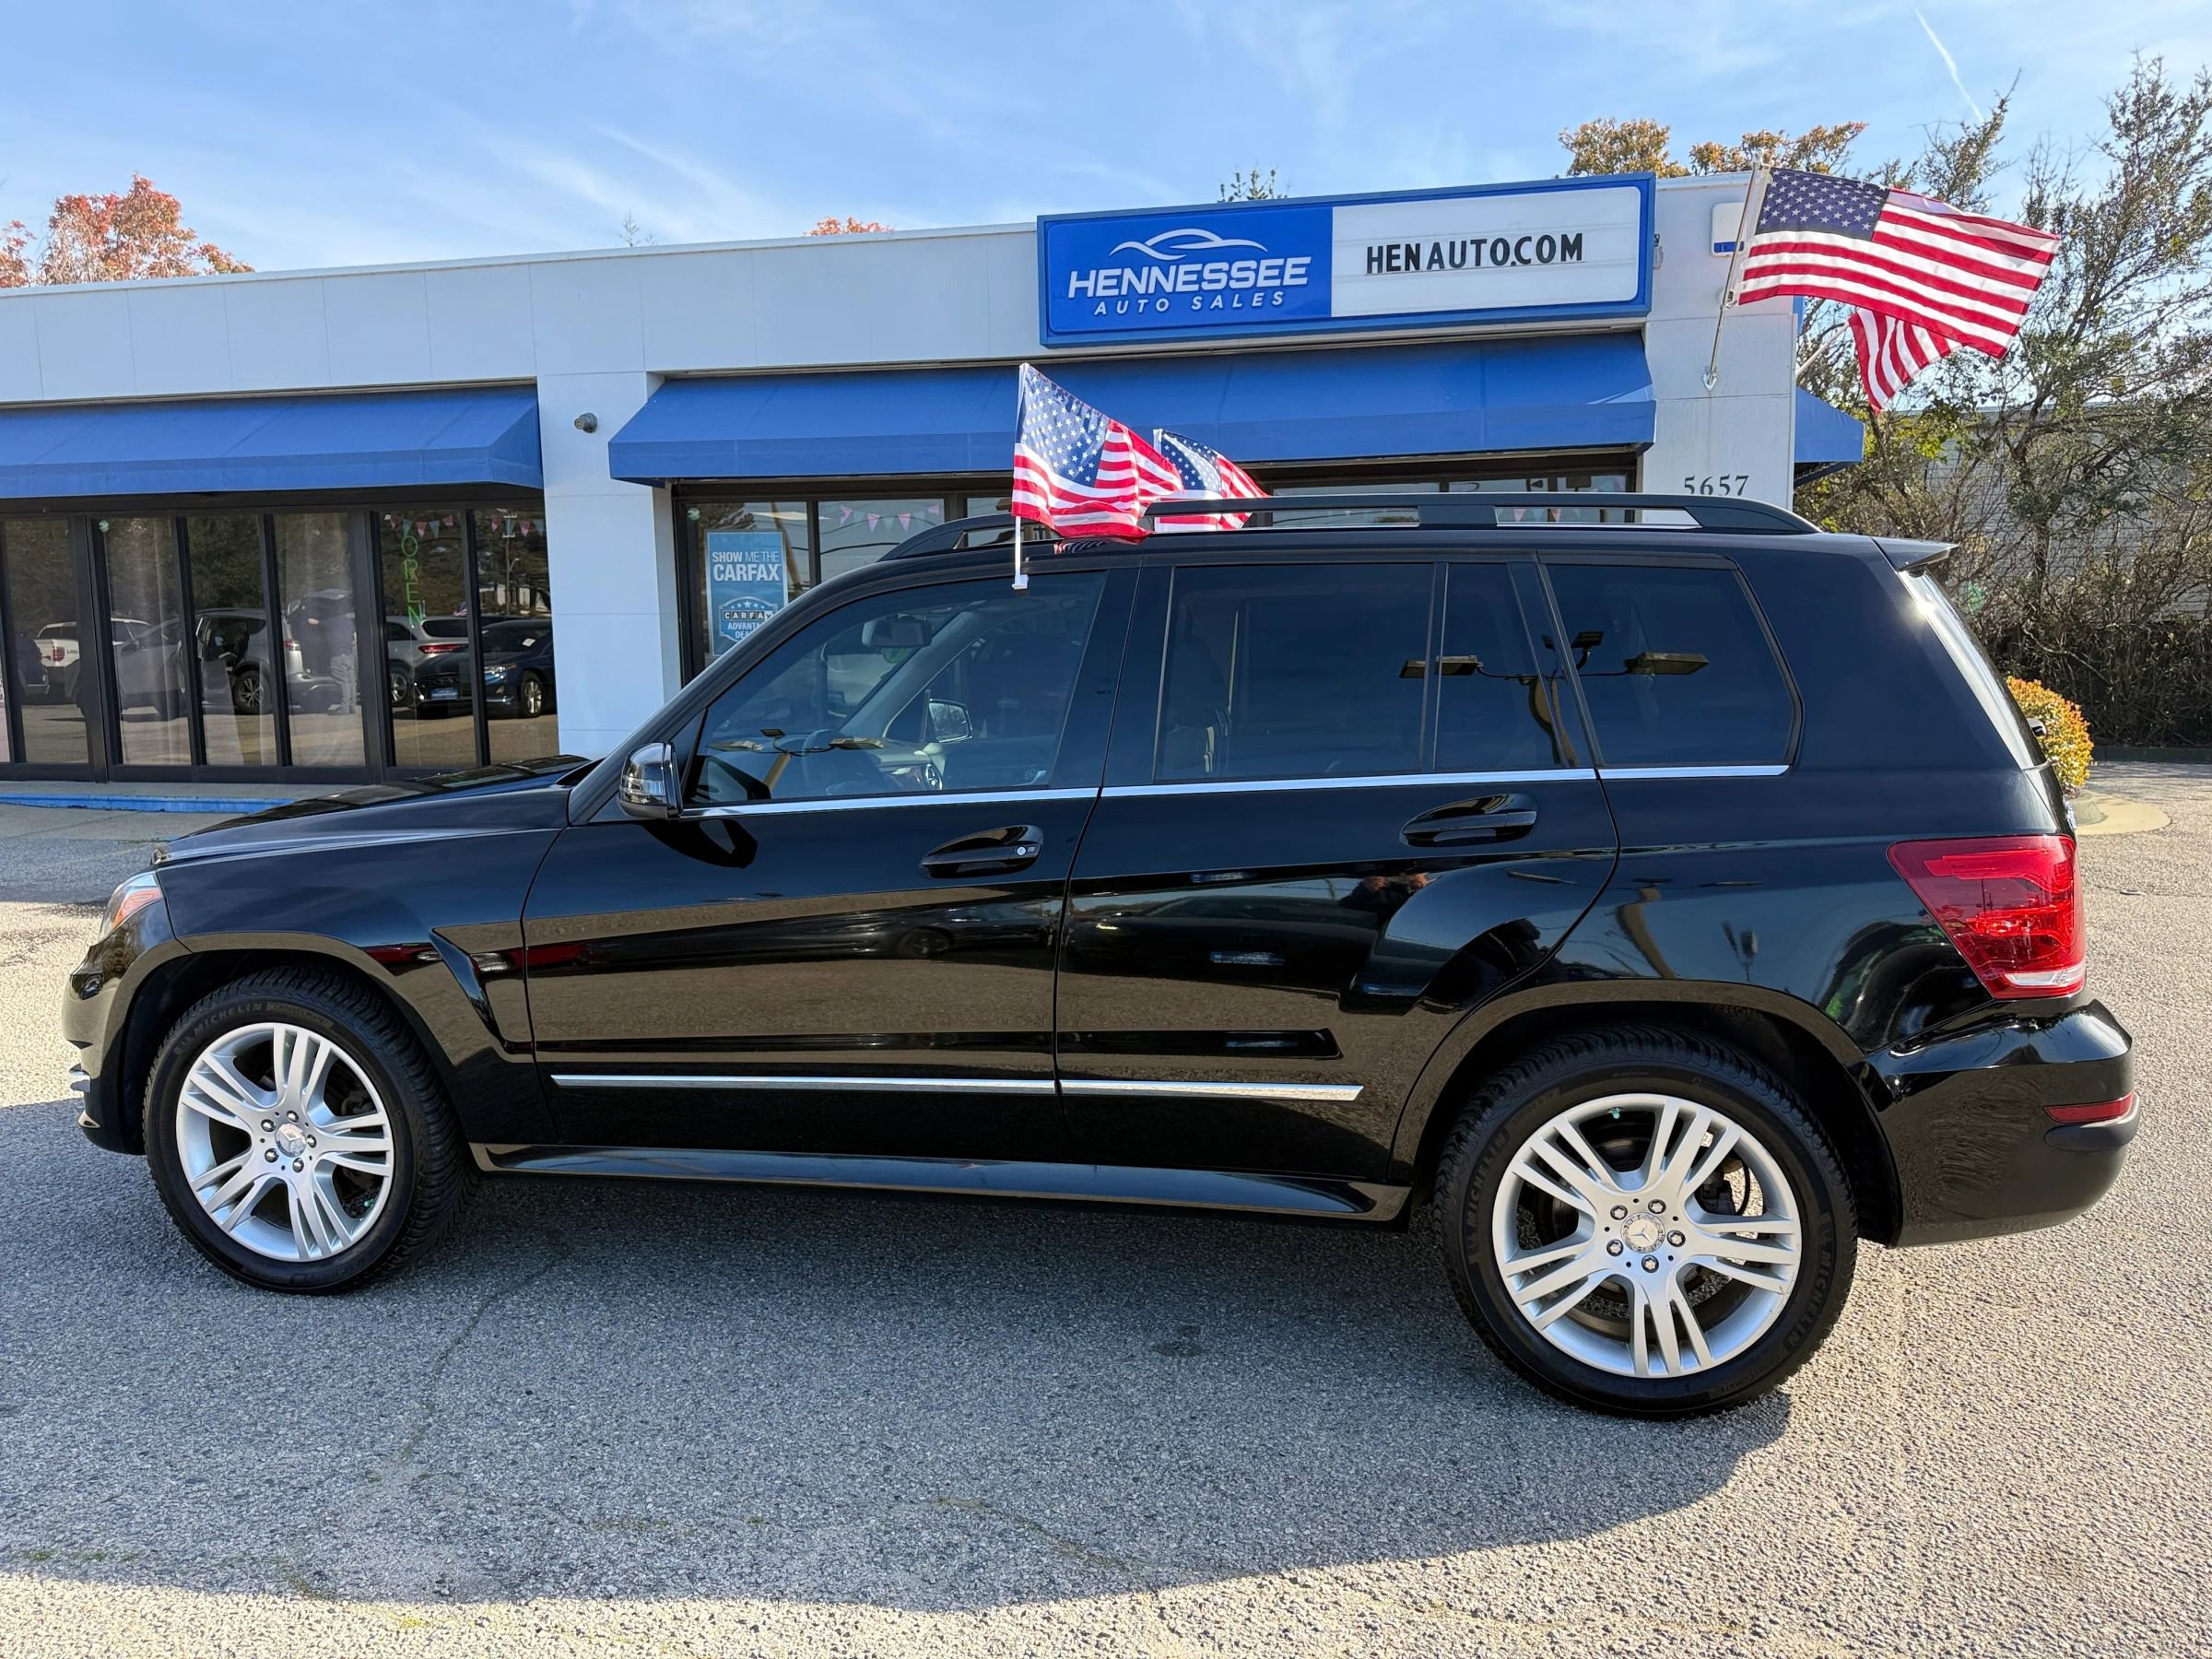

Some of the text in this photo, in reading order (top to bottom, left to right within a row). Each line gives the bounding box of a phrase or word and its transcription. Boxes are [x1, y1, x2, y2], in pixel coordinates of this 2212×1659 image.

[1367, 233, 1583, 274] HENAUTO.COM
[1068, 256, 1312, 298] HENNESSEE
[1094, 291, 1284, 315] AUTO SALES
[1684, 474, 1749, 496] 5657
[712, 551, 780, 563] SHOW ME THE
[712, 563, 782, 582] CARFAX
[194, 1003, 263, 1037] MICHELIN
[1467, 1134, 1507, 1227] MICHELIN
[1787, 1250, 1832, 1348] MICHELIN
